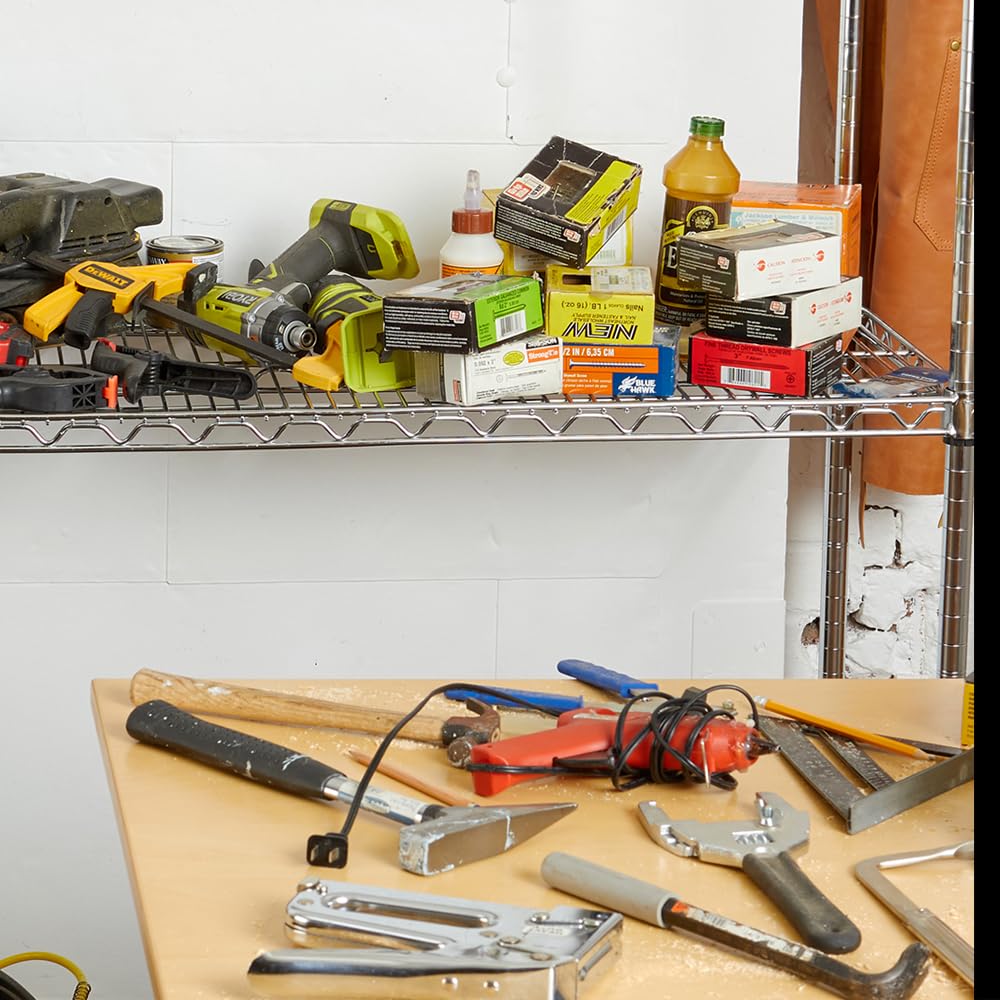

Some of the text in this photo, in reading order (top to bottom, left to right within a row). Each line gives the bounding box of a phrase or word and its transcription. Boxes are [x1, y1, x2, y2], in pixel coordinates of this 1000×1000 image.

[85, 265, 129, 288] DEWALT
[221, 290, 257, 305] RYOBI
[625, 304, 644, 312] Nails
[562, 322, 638, 340] NEW
[572, 347, 581, 356] IN
[603, 348, 615, 357] CM
[635, 379, 656, 387] BLUE
